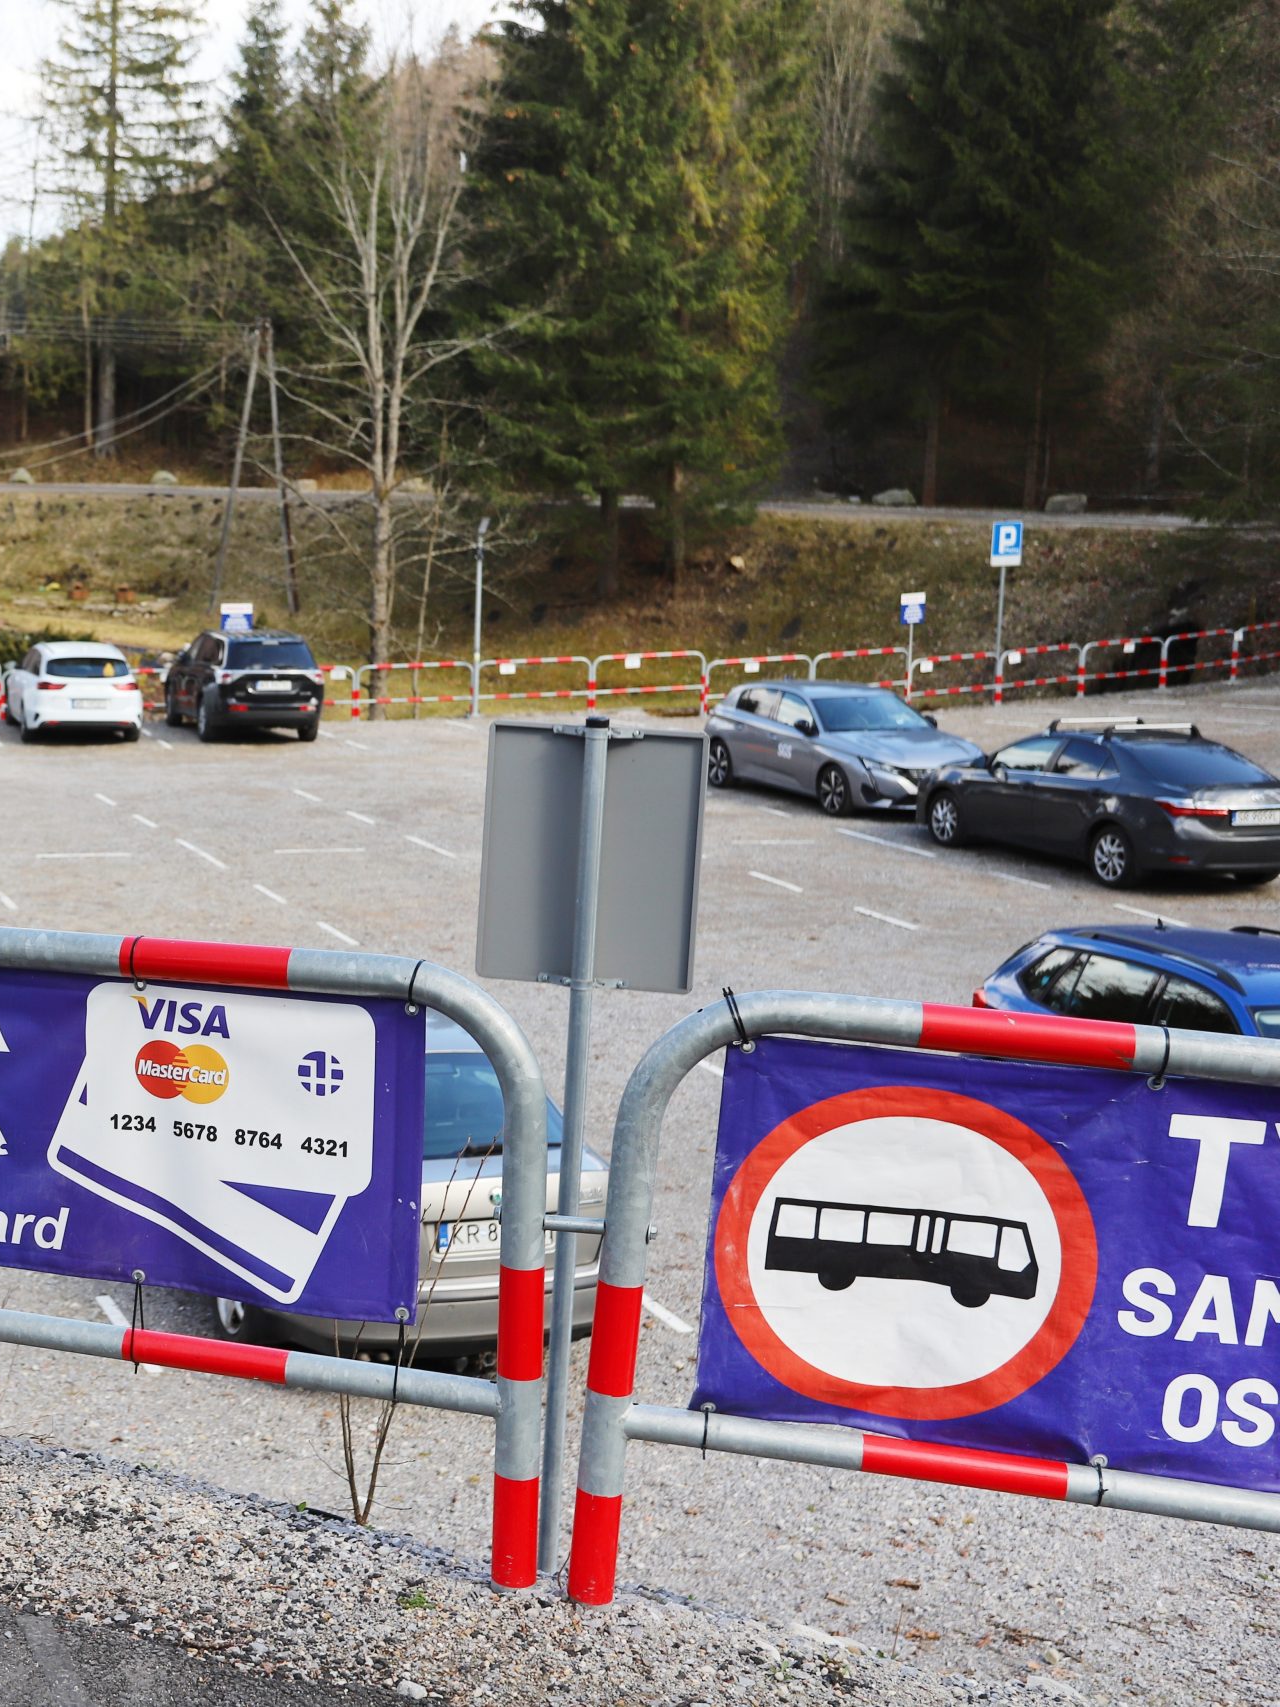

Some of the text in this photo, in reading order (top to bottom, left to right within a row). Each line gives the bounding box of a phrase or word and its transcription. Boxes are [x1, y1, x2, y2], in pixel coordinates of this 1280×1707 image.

[998, 525, 1018, 555] P
[130, 995, 231, 1040] VISA
[136, 1058, 227, 1087] MasterCard
[109, 1113, 349, 1158] 1234 5678 8764 4321
[1168, 1112, 1280, 1228] T
[451, 1223, 481, 1245] KR
